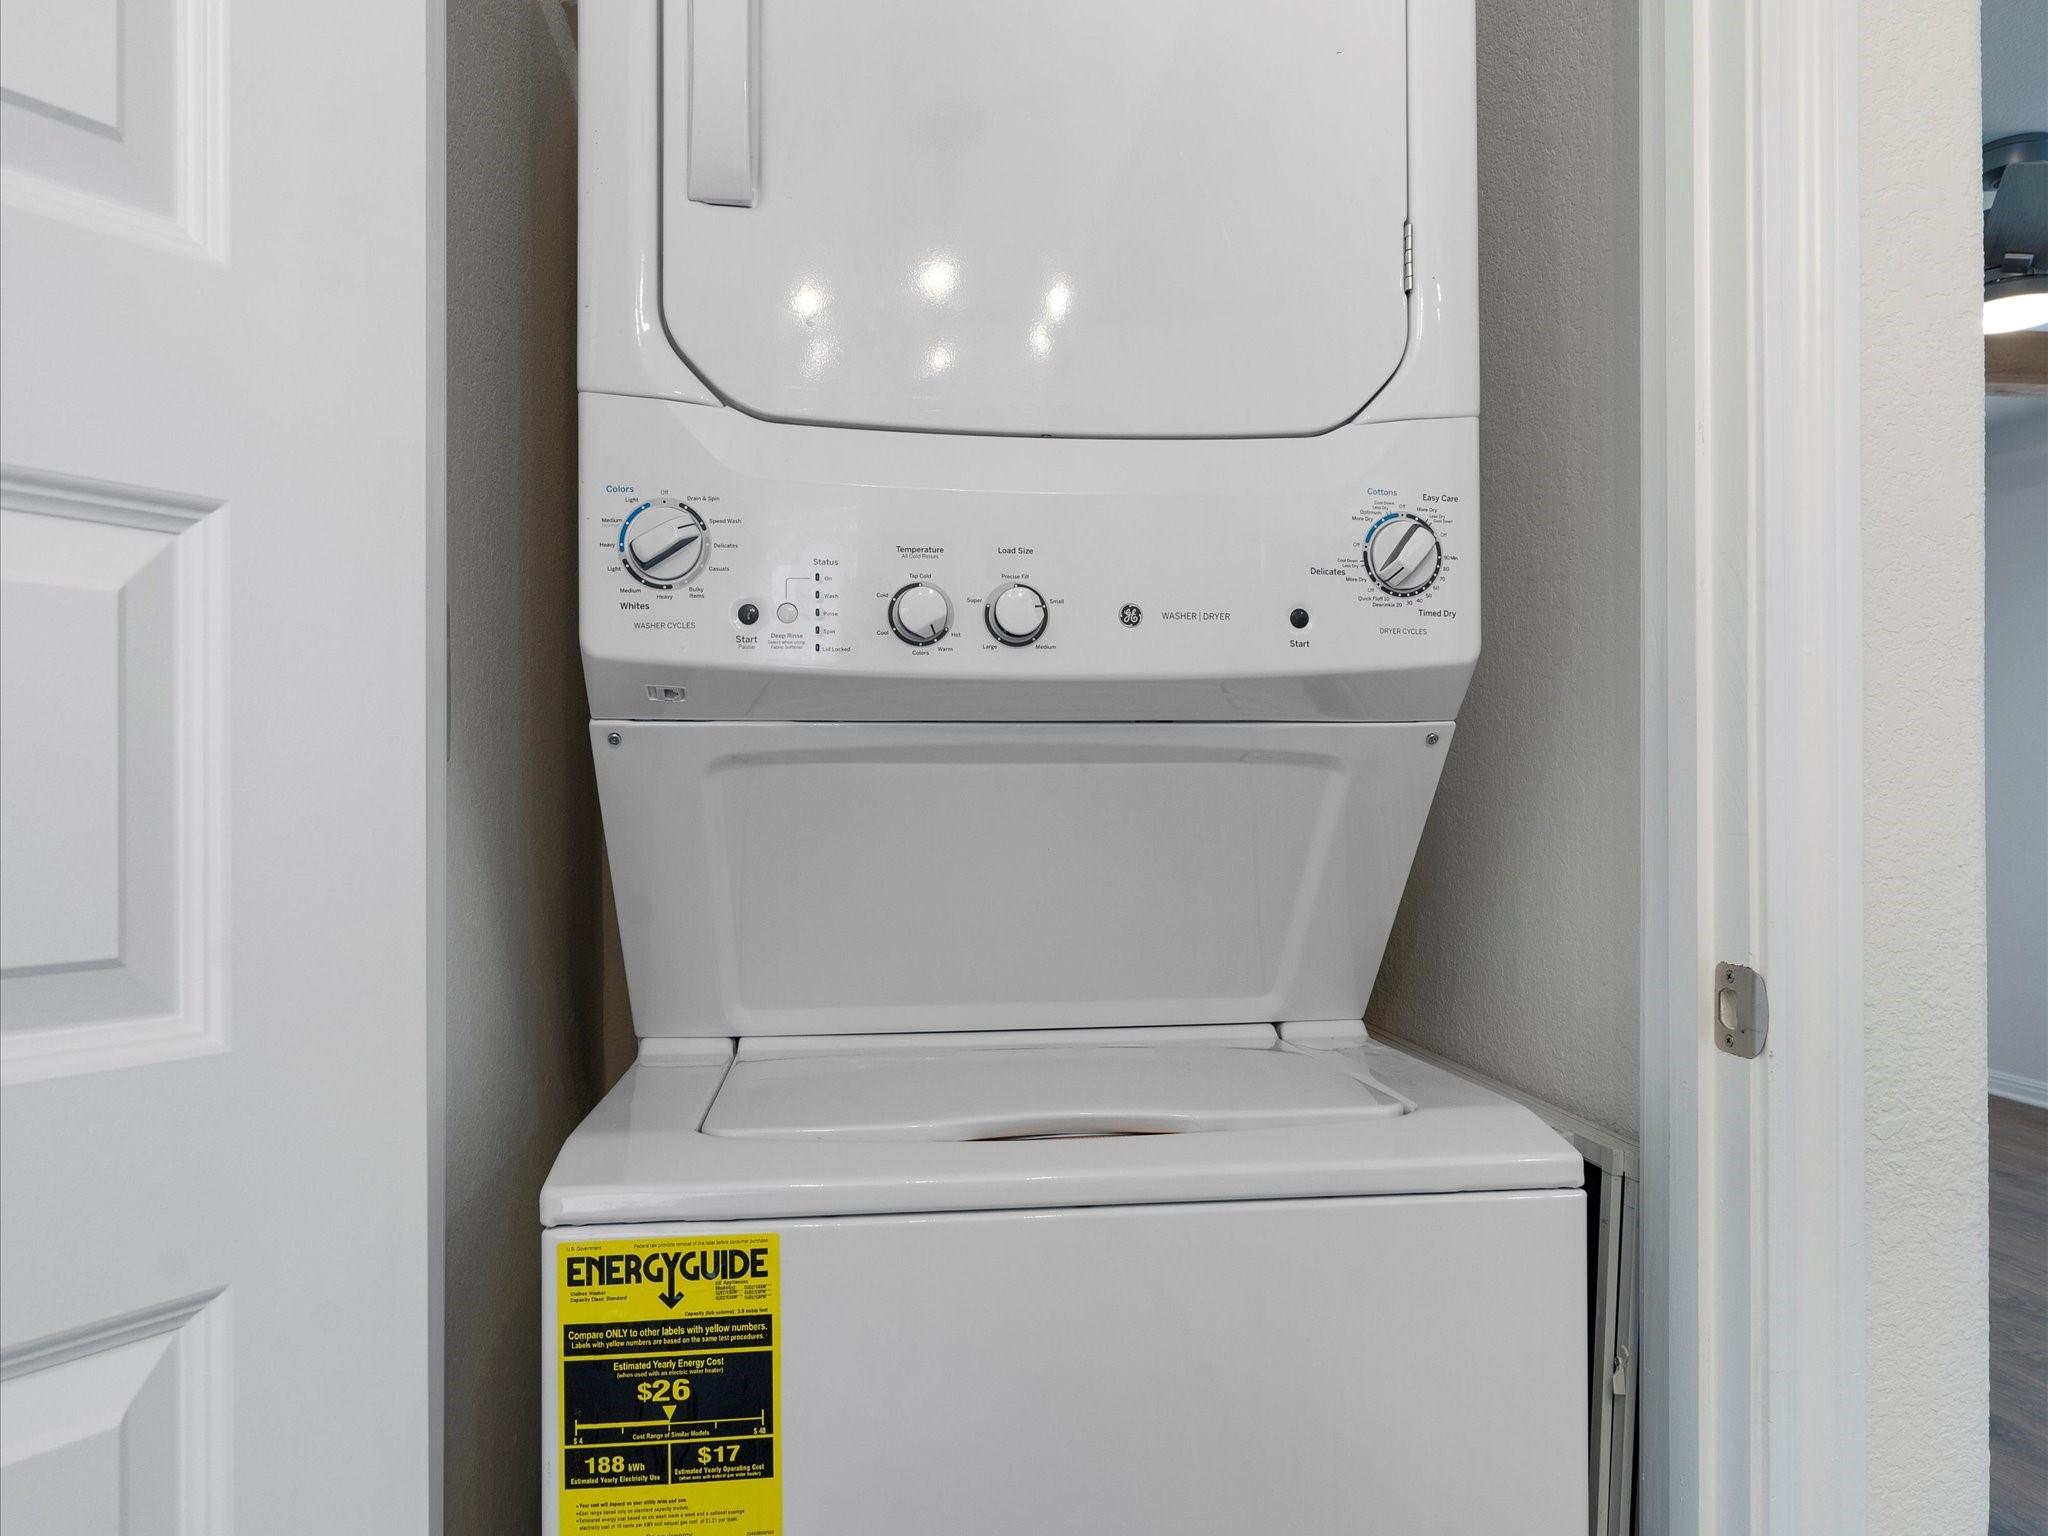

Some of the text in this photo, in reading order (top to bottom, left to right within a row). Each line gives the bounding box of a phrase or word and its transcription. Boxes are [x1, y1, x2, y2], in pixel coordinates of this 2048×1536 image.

[606, 485, 634, 493] Colors
[1367, 488, 1397, 496] Cottons
[1423, 494, 1440, 502] Easy
[896, 546, 944, 554] Temperature
[620, 602, 650, 610] Whites
[1203, 613, 1230, 621] DRYER
[1419, 609, 1456, 619] Timed Dry
[1290, 640, 1310, 648] Start
[567, 1248, 768, 1288] ENERGYGUIDE
[568, 1330, 604, 1341] Compare
[606, 1329, 628, 1338] ONLY
[639, 1327, 660, 1336] other
[662, 1325, 685, 1335] labels
[687, 1325, 703, 1334] with
[705, 1324, 730, 1335] yellow
[732, 1322, 768, 1332] numbers.
[571, 1341, 591, 1349] Labels
[606, 1340, 625, 1349] yellow
[731, 1333, 764, 1341] procedures.
[613, 1357, 724, 1371] Estimated Yearly Energy Cost
[637, 1378, 690, 1403] $26
[646, 1432, 664, 1440] Range
[698, 1445, 741, 1465] $17
[585, 1456, 645, 1474] 188 kWh
[723, 1465, 750, 1473] Operating
[752, 1463, 764, 1471] Cost
[570, 1477, 598, 1485] Estimated
[600, 1476, 618, 1485] Yearly
[620, 1475, 648, 1483] Electricity
